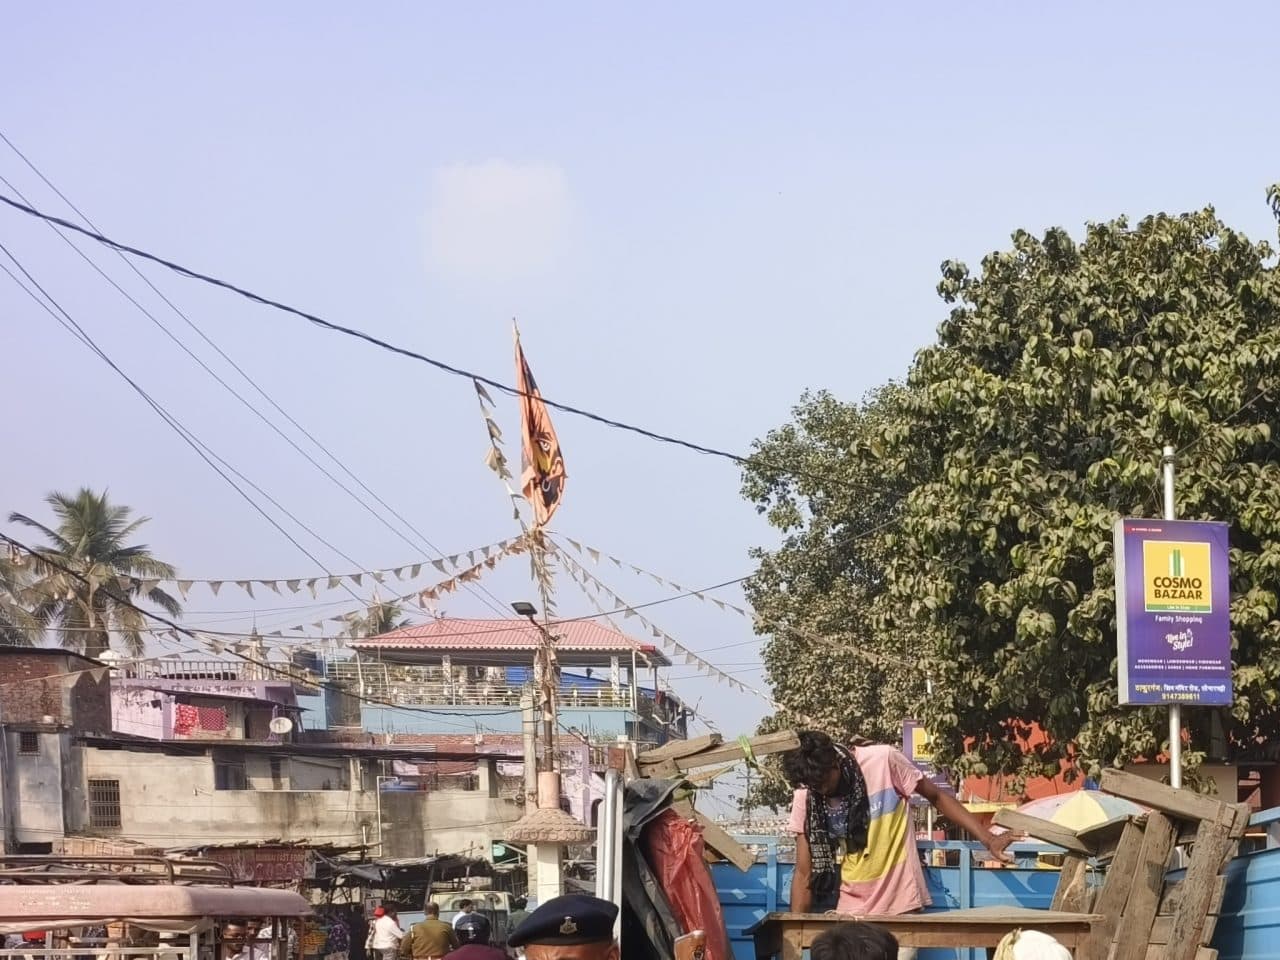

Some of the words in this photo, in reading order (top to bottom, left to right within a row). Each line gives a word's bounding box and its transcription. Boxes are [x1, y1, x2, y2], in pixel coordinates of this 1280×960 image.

[1153, 576, 1202, 590] COSMO
[1154, 589, 1203, 600] BAZAAR
[1155, 615, 1174, 624] Family
[1175, 616, 1203, 625] Shopping
